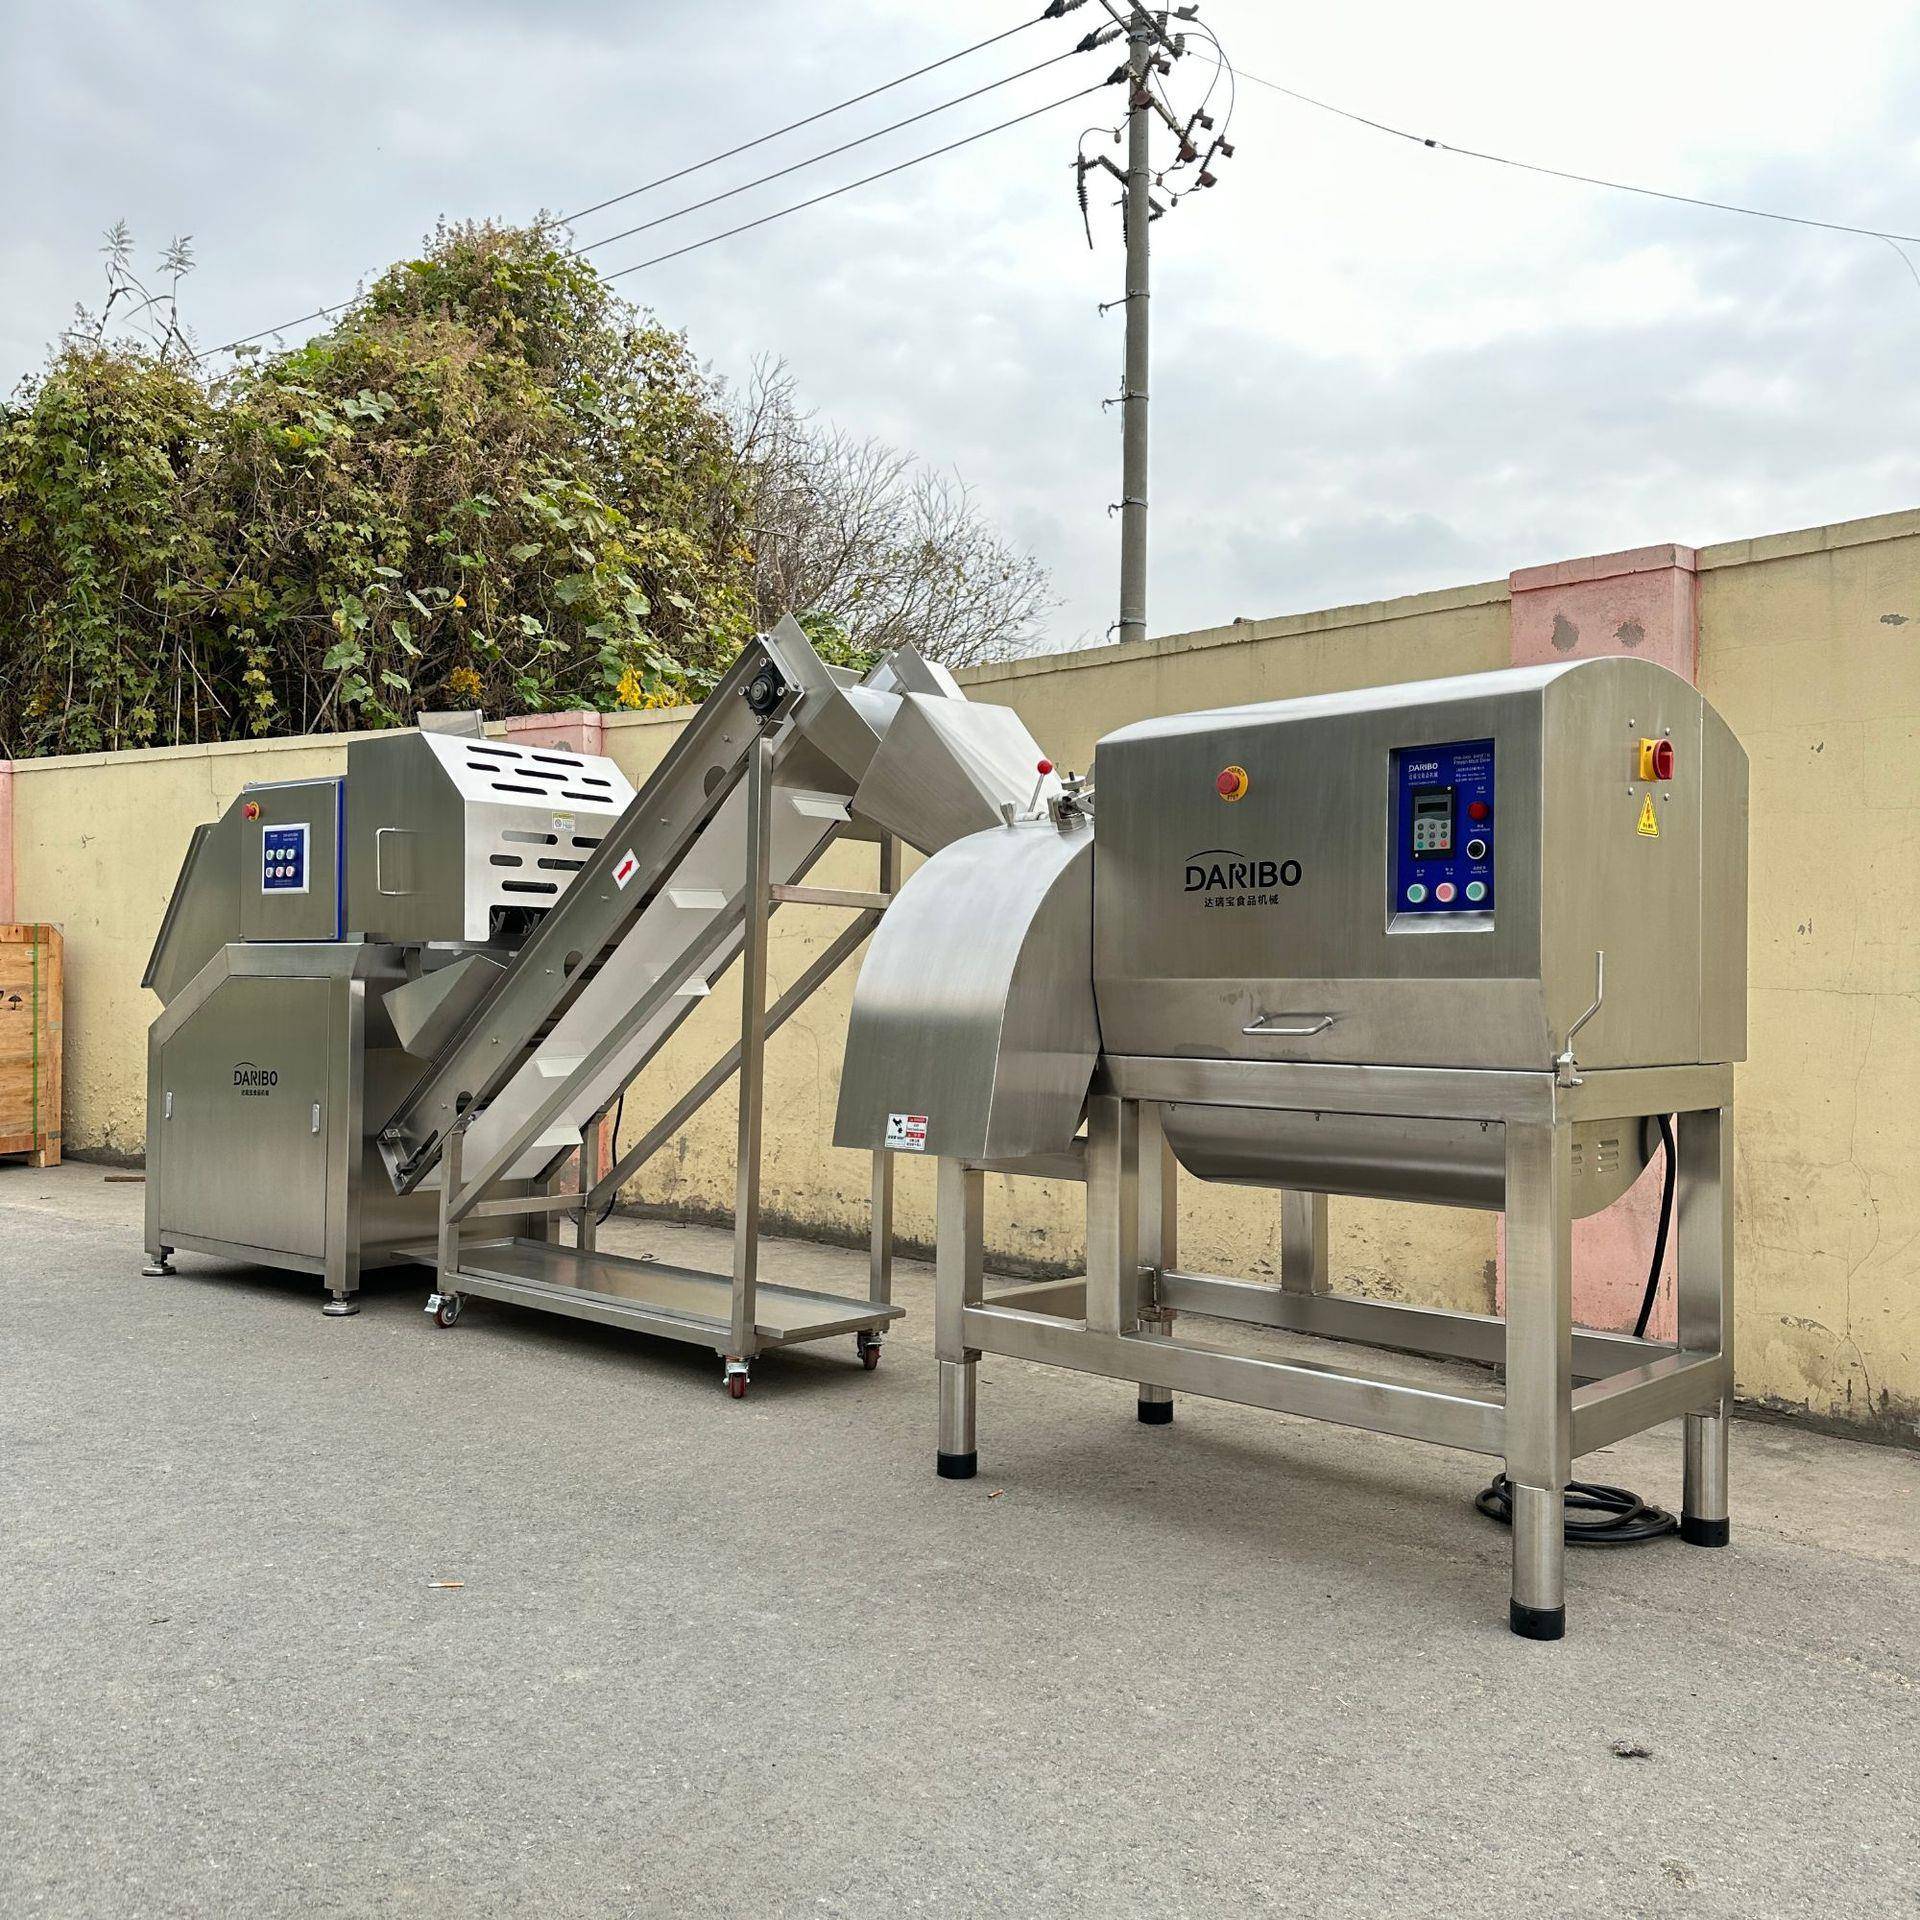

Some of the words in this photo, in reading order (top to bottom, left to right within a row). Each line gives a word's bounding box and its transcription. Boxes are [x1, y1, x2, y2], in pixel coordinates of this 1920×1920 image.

[1408, 763, 1438, 772] DARIBO
[1184, 860, 1302, 891] DARIBO
[233, 1070, 278, 1086] DARIBO
